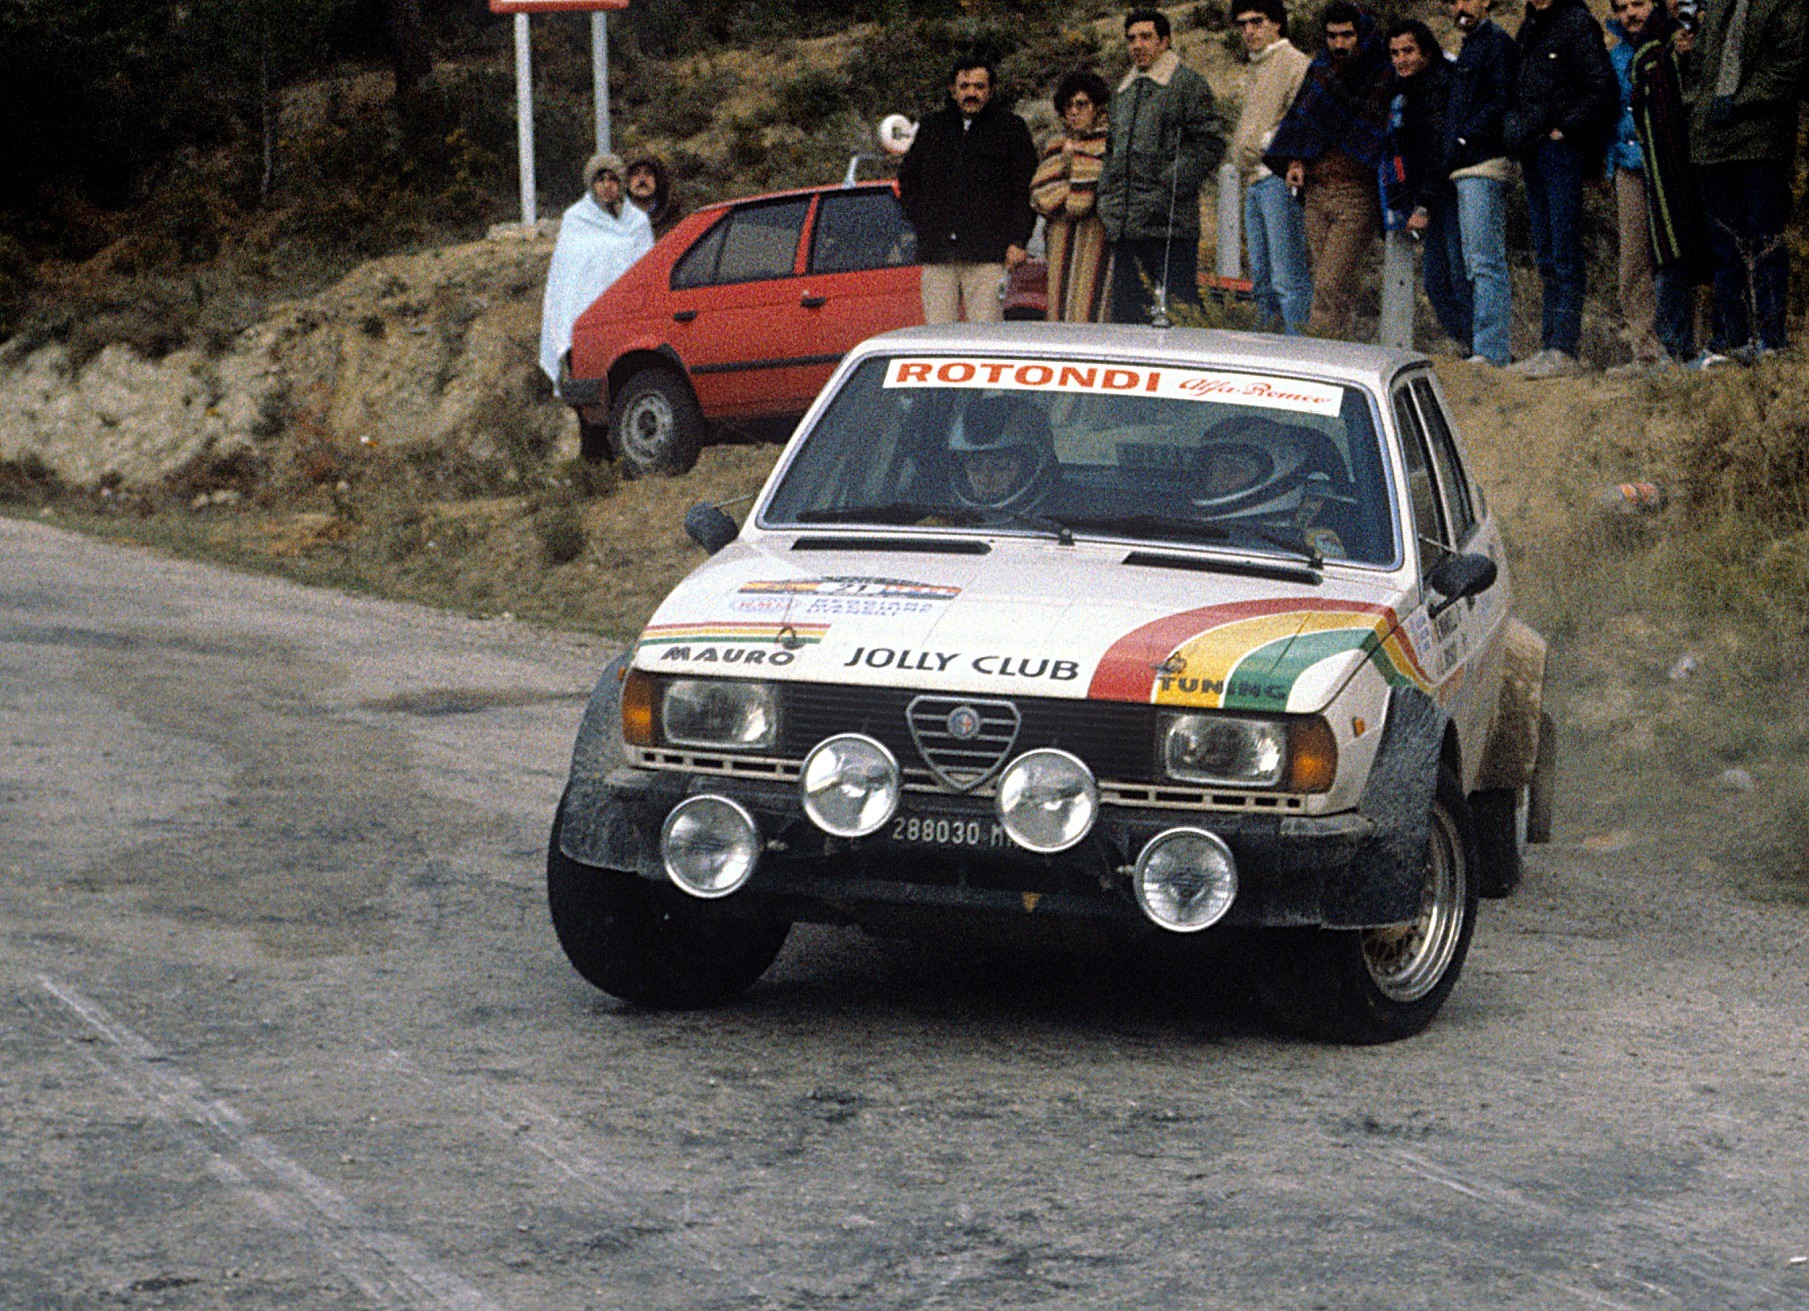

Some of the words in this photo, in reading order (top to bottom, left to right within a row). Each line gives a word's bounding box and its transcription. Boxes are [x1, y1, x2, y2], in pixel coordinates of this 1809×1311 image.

[894, 361, 1162, 393] ROTONDI
[1178, 377, 1237, 397] Alfa
[1242, 381, 1332, 405] Romeo
[660, 646, 797, 667] MAURO
[843, 646, 962, 672] JOLLY
[970, 655, 1081, 682] CLUB
[1158, 676, 1287, 700] TUNING
[892, 817, 981, 845] 288030
[990, 823, 1012, 848] M
